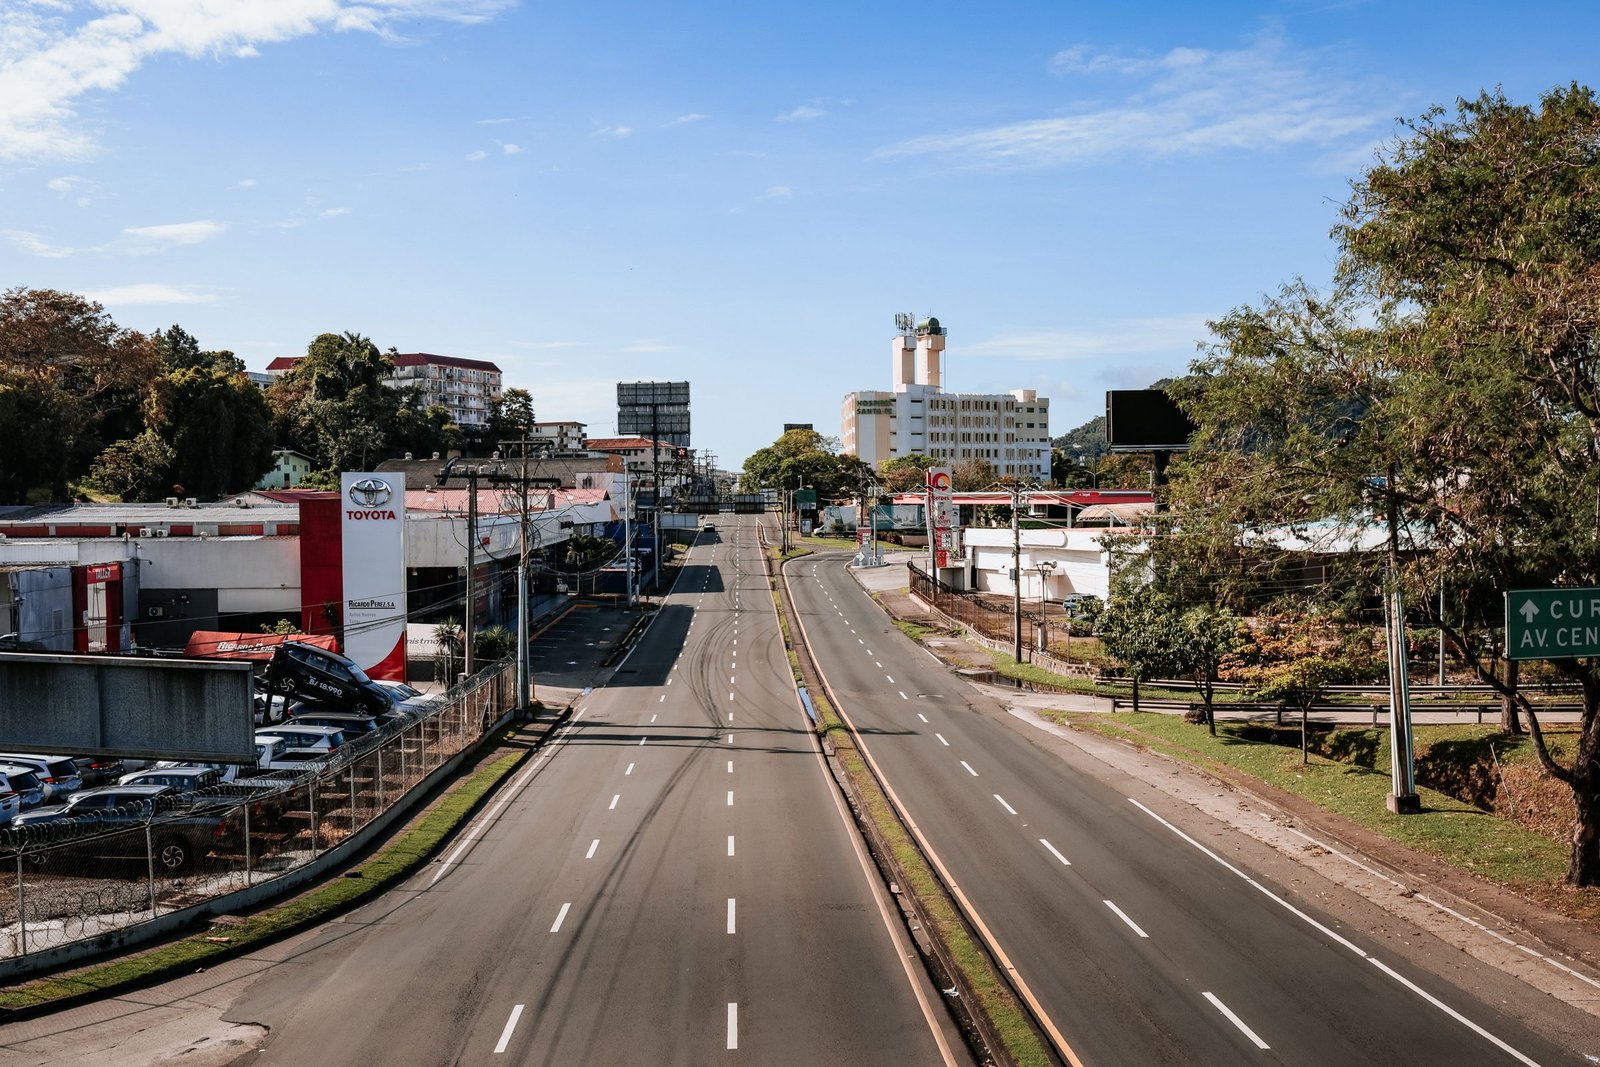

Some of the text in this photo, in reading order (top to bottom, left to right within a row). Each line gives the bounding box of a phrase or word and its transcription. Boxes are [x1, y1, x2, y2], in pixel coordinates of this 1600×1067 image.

[347, 510, 396, 520] TOYOTA
[1550, 600, 1600, 619] CUR
[1520, 627, 1598, 648] AV. CEN
[319, 682, 343, 696] 18.990
